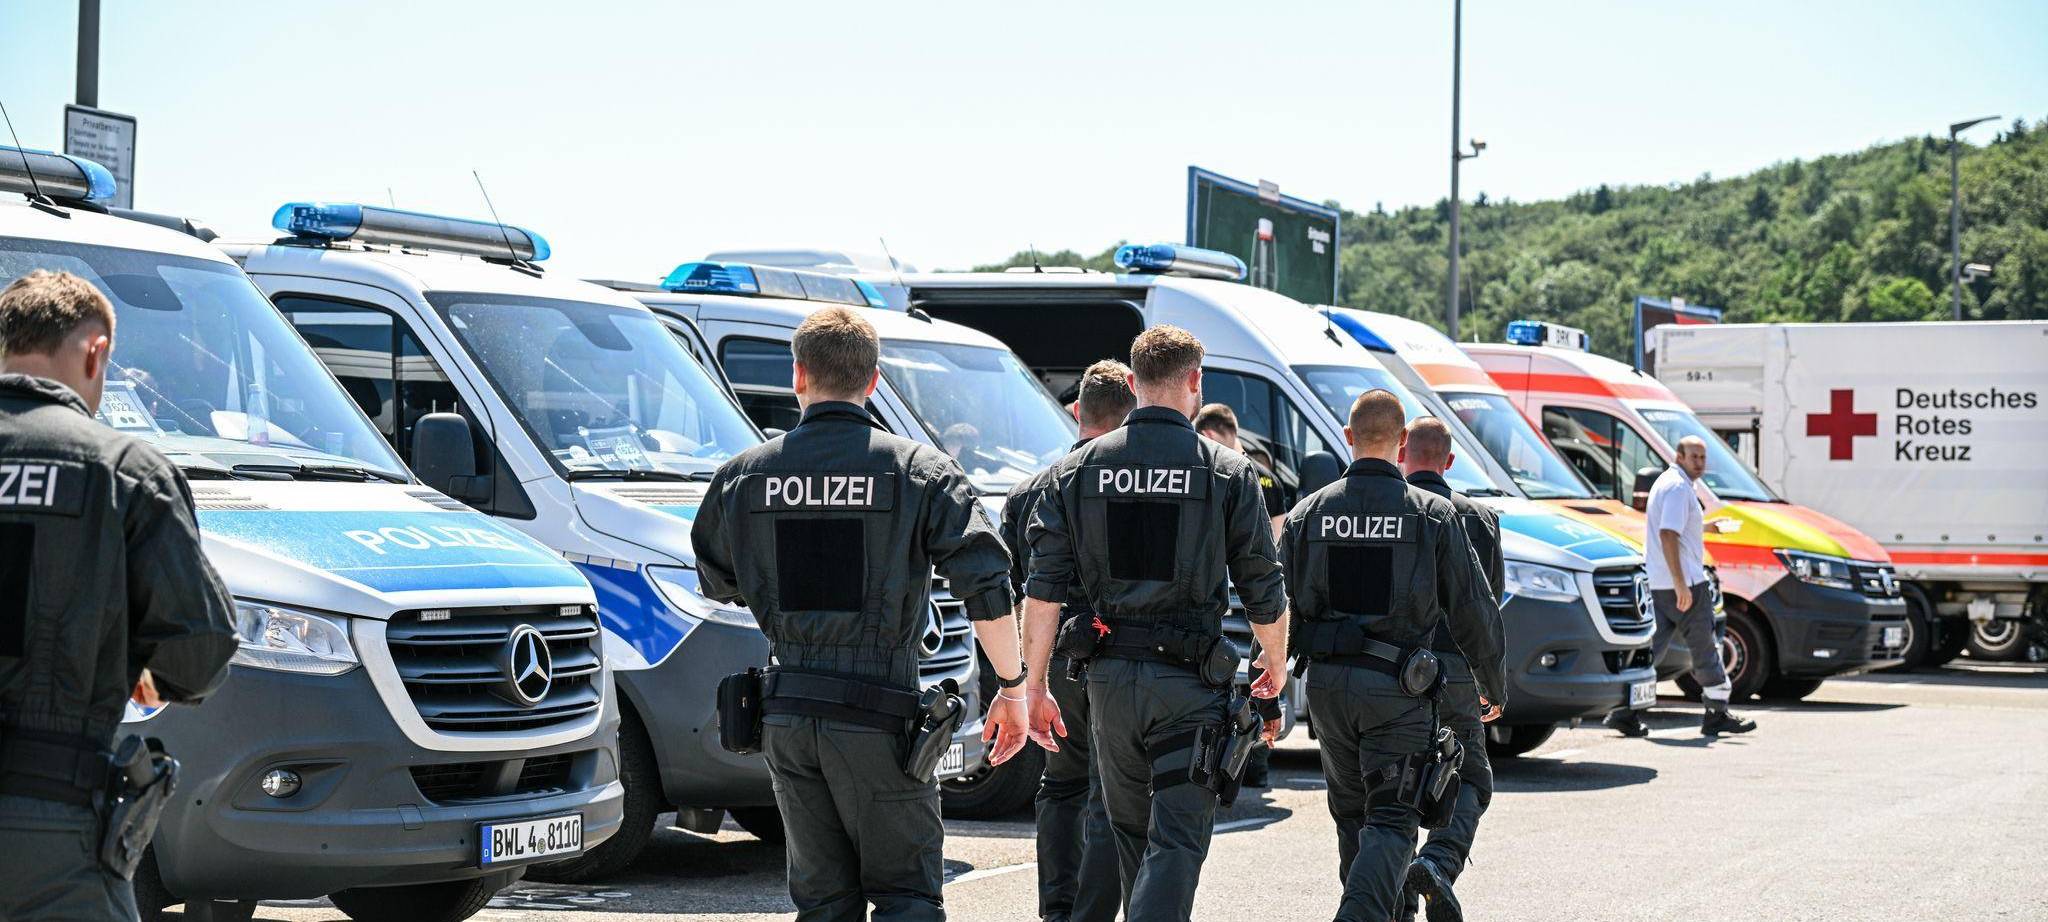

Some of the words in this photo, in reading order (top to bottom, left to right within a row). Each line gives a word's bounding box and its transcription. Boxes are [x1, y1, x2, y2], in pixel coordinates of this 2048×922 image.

[1896, 388, 2037, 409] Deutsches
[1896, 415, 1972, 435] Rotes
[1895, 440, 1971, 461] Kreuz
[0, 464, 58, 506] ZEI
[765, 476, 874, 506] POLIZEI
[1098, 469, 1191, 494] POLIZEI
[1321, 515, 1403, 538] POLIZEI
[342, 526, 529, 555] POLIZEI
[493, 828, 524, 857] BWL
[528, 825, 537, 852] 4
[547, 819, 580, 850] 8110
